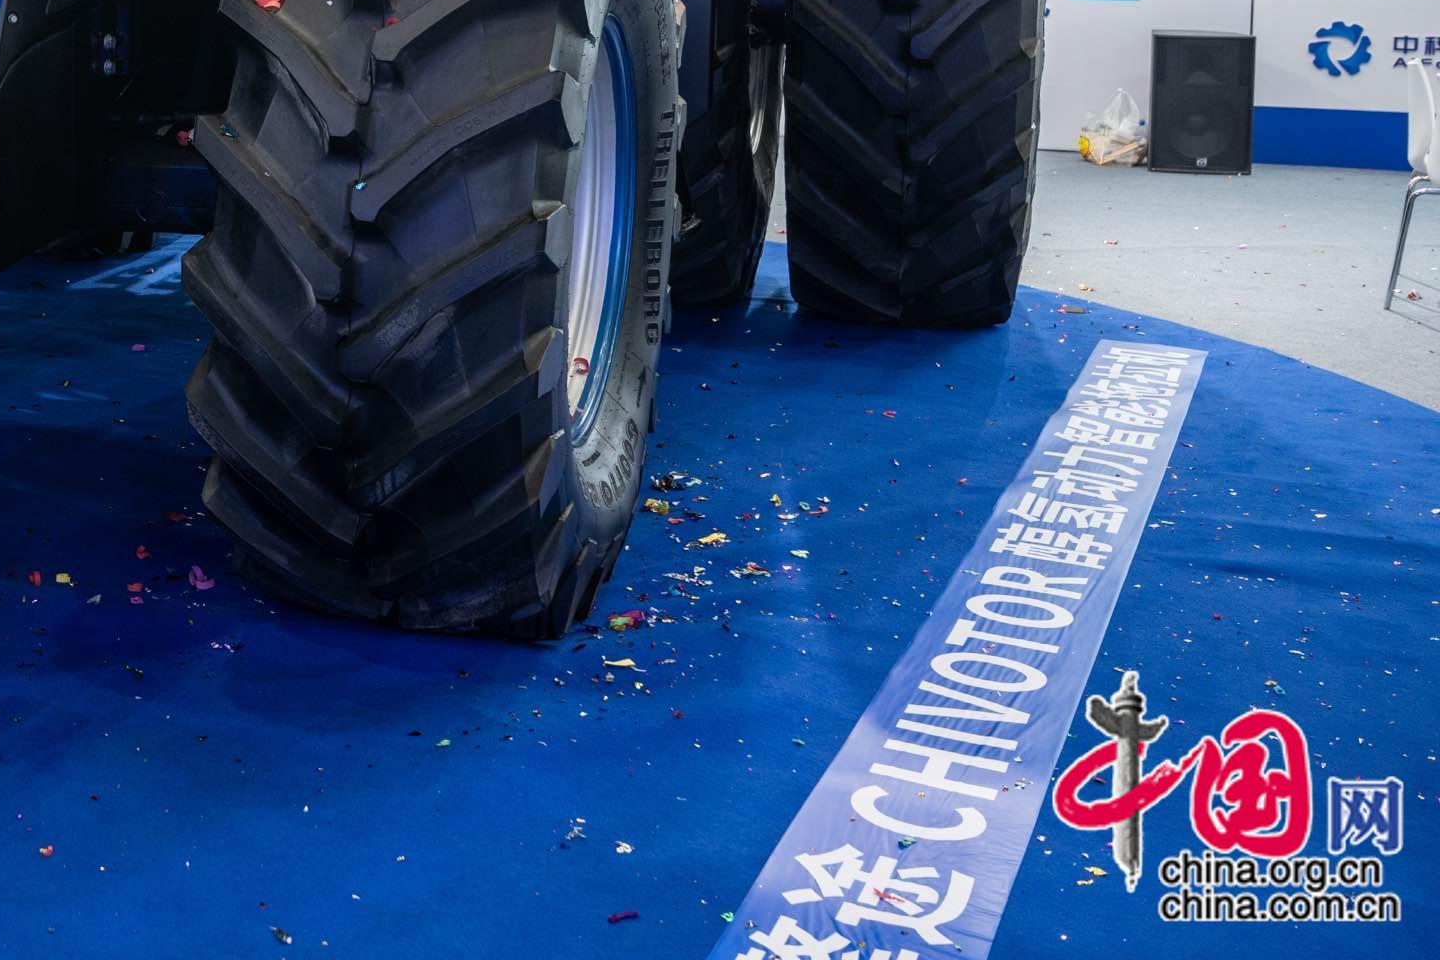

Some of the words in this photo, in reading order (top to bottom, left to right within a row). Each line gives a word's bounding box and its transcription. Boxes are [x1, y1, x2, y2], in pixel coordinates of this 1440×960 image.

[644, 103, 676, 347] TRELLEBORG
[850, 565, 1090, 841] CHIVOTOR
[989, 346, 1192, 570] 醇氢动力智能拖拉机
